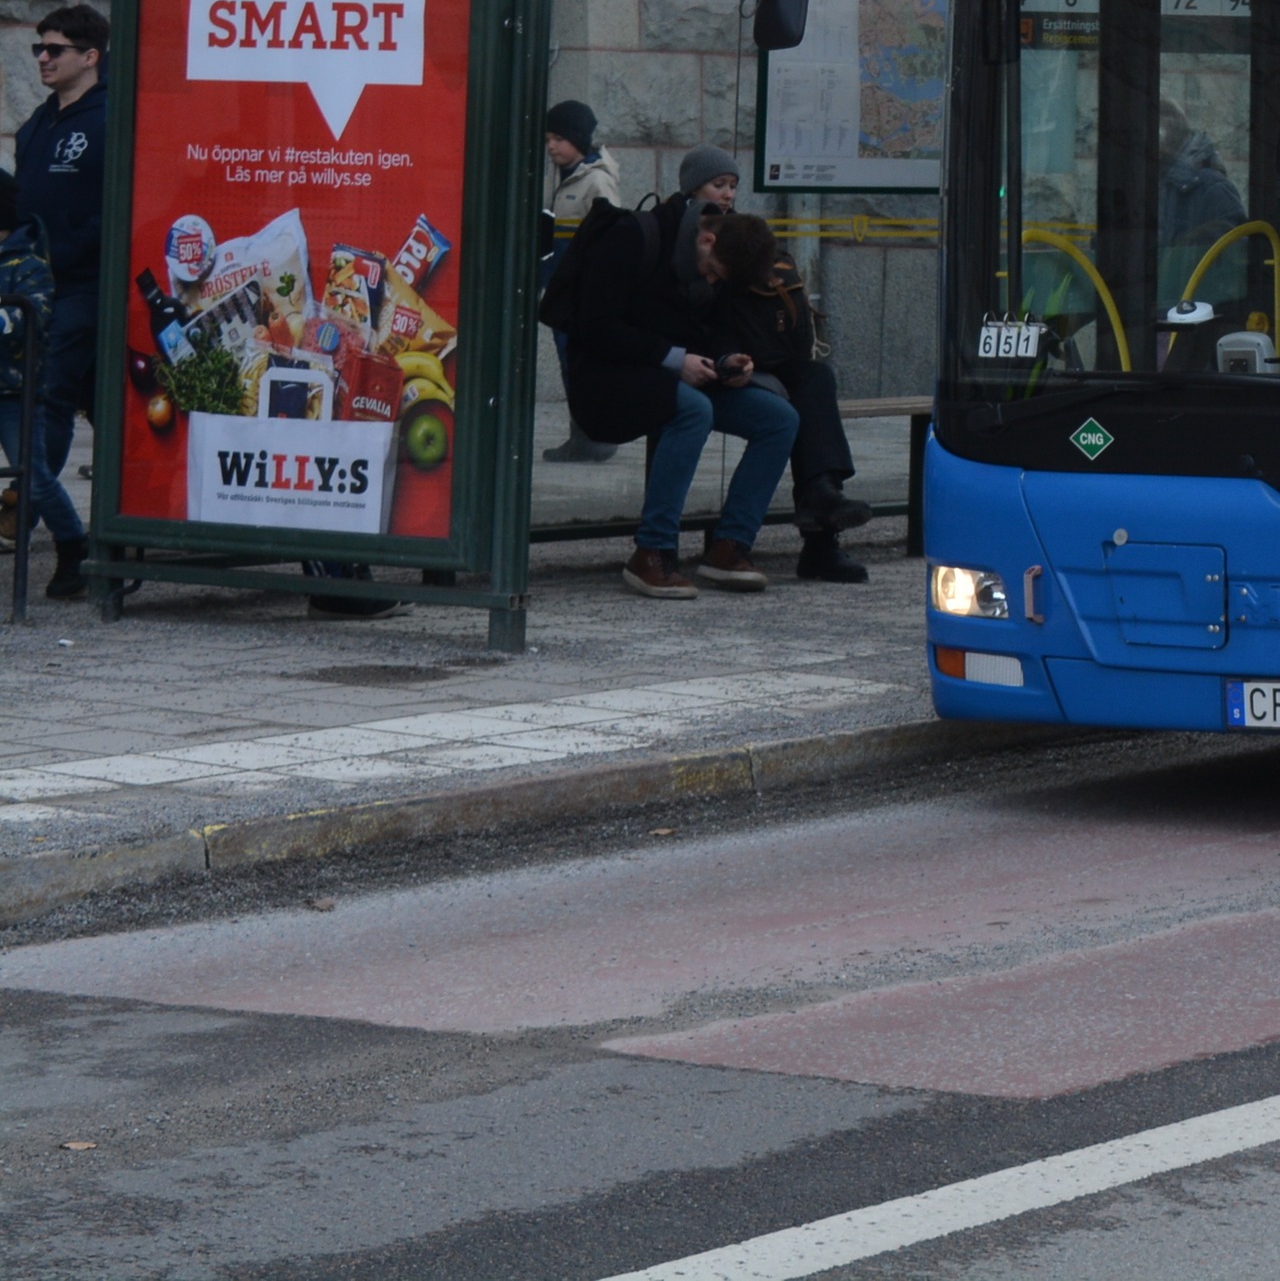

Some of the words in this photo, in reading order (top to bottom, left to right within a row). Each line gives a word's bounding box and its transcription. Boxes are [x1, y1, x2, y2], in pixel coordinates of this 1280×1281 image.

[208, 0, 404, 51] SMART
[187, 144, 208, 160] Nu
[212, 146, 264, 164] öppnar
[268, 147, 280, 162] vi
[285, 147, 373, 166] #restakuten
[378, 149, 413, 169] igen.
[226, 166, 250, 182] Läs
[255, 170, 283, 183] mer
[288, 166, 306, 187] på
[311, 168, 371, 188] willys.se
[180, 243, 201, 261] 50%
[393, 313, 417, 334] 30%
[982, 334, 1030, 354] 651
[352, 396, 391, 418] GEVALIA
[1079, 432, 1104, 445] CNG
